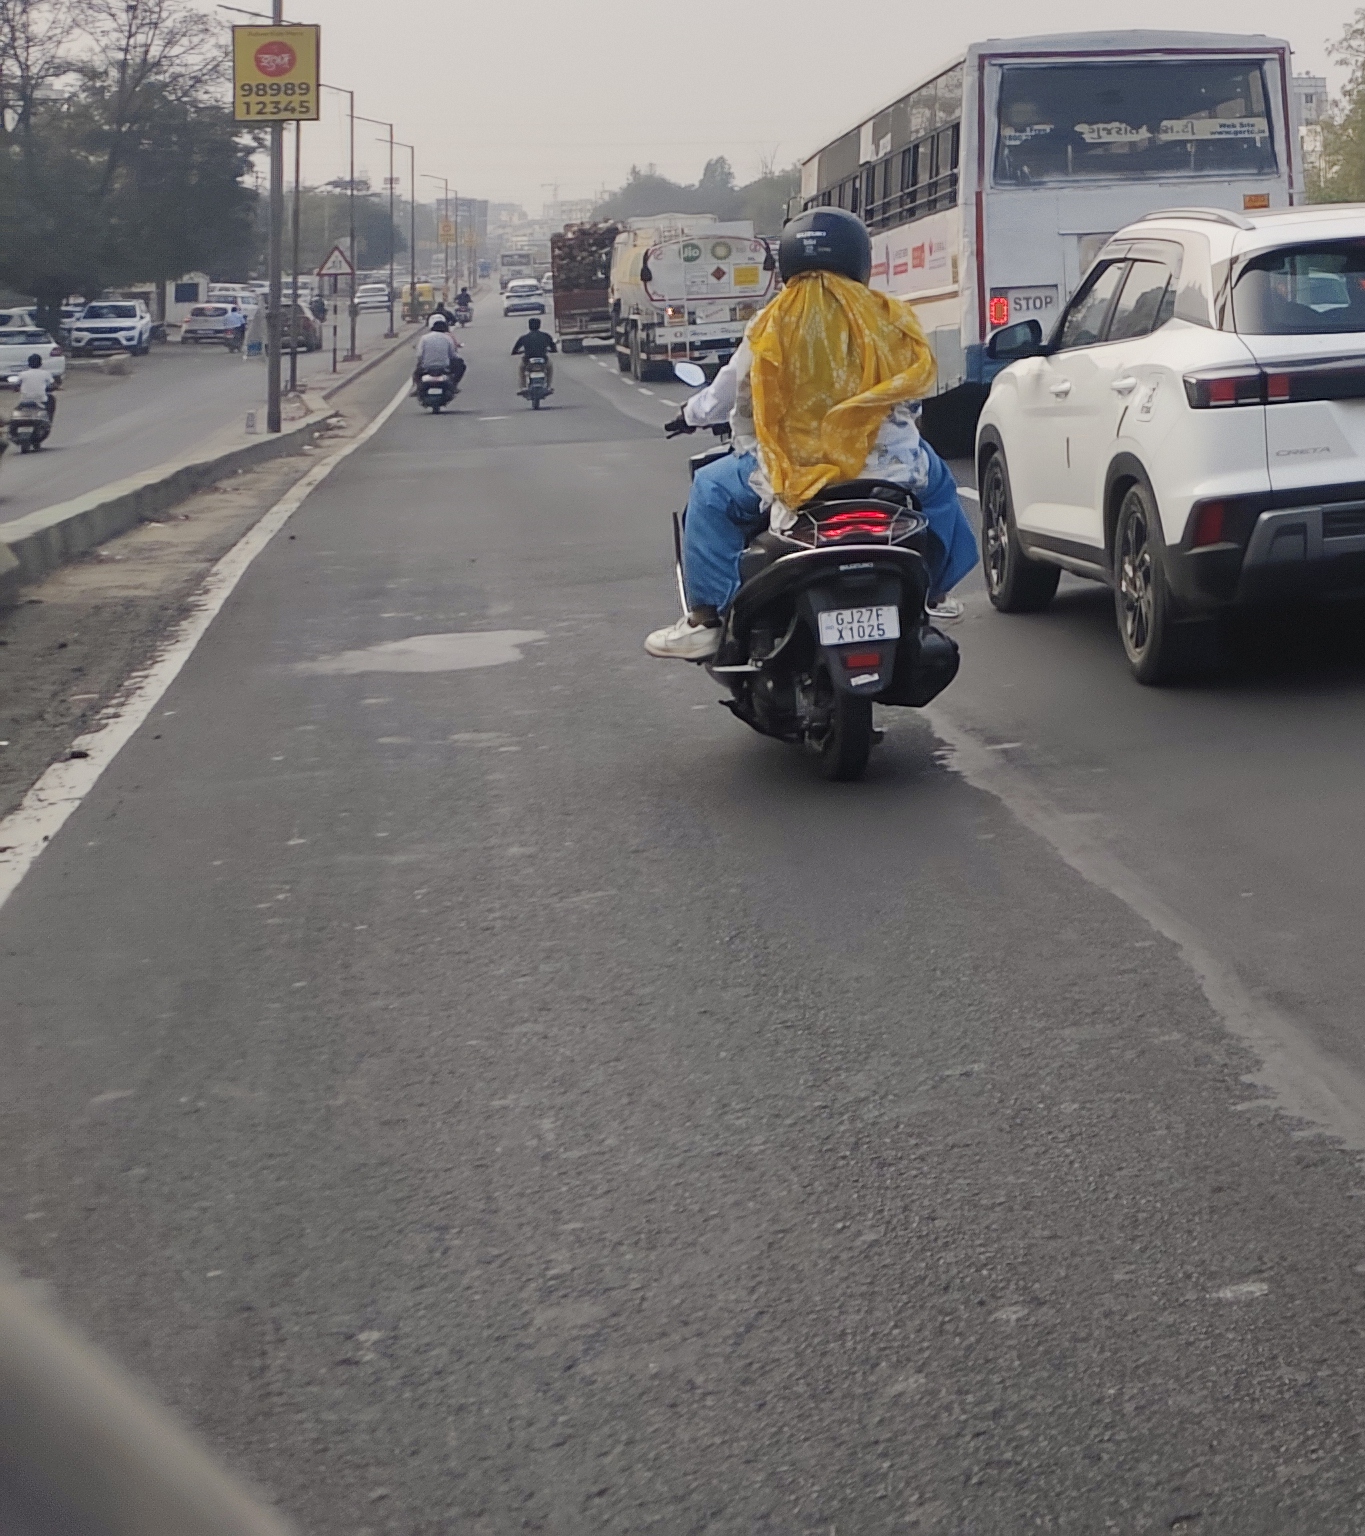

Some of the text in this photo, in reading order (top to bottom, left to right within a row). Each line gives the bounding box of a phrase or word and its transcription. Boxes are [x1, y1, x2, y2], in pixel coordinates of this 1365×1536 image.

[240, 82, 310, 97] 98989
[243, 100, 310, 115] 12345
[1160, 121, 1195, 136] સ.ટી
[684, 246, 700, 256] Jio
[1014, 295, 1052, 311] STOP
[1276, 446, 1330, 456] CRETA
[836, 608, 884, 626] GJ27F
[837, 623, 886, 641] X1025
